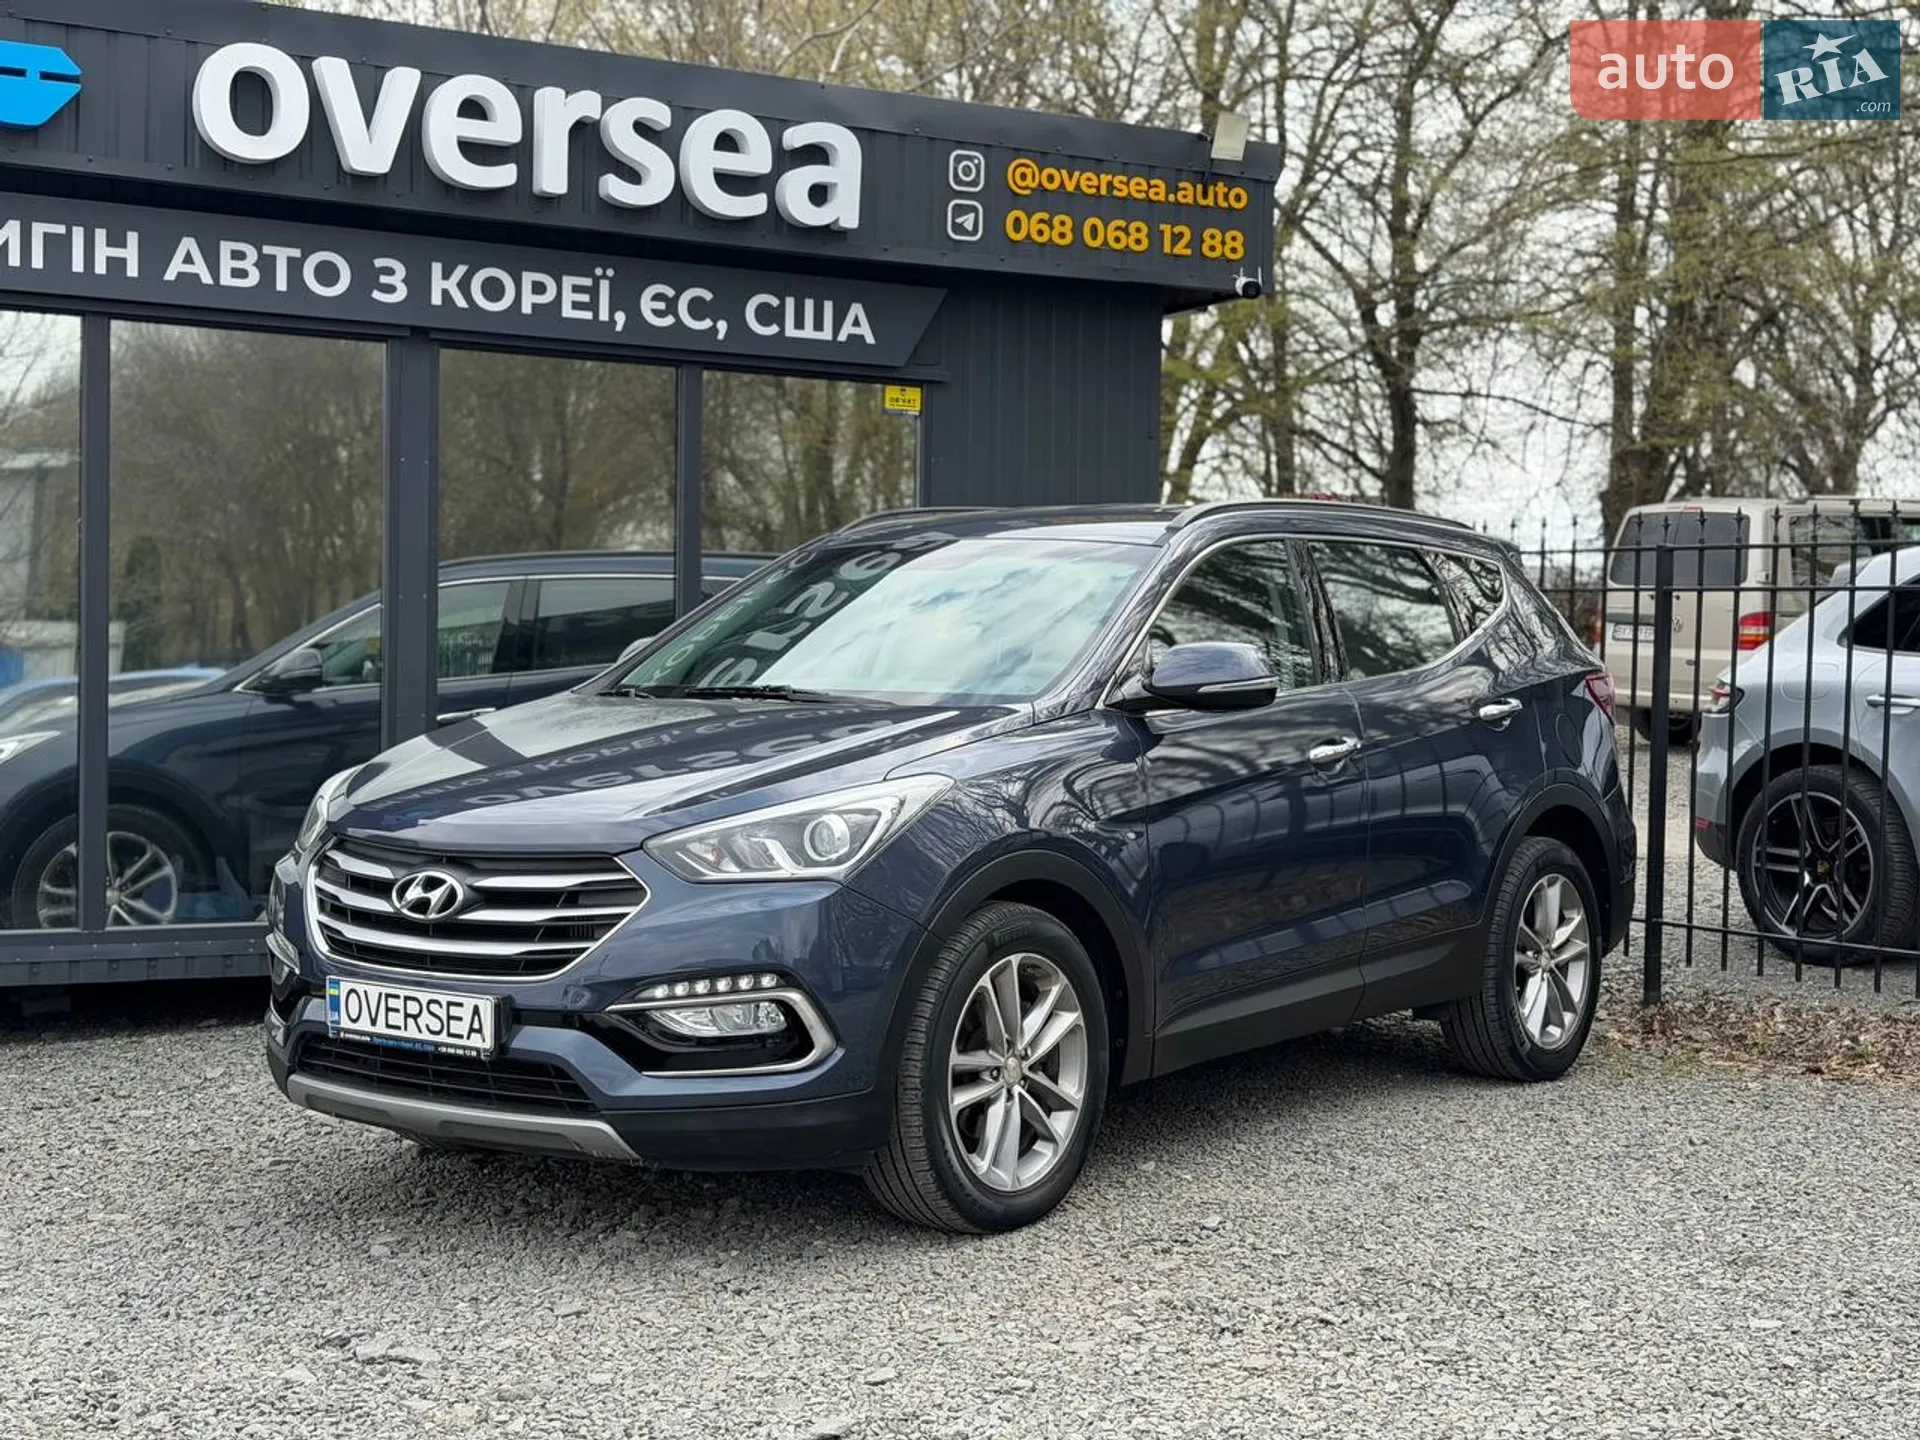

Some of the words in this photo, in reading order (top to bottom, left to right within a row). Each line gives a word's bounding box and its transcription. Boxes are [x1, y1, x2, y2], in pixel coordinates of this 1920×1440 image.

[192, 41, 864, 230] oversea
[1006, 157, 1249, 211] @oversea.auto
[1004, 209, 1074, 246] 068
[1082, 216, 1149, 252] 068
[1159, 223, 1193, 256] 12
[1201, 227, 1246, 261] 88
[162, 236, 352, 298] АВТО
[371, 257, 408, 304] З
[430, 261, 627, 332] КОРЕЇ,
[639, 283, 728, 341] ЄС,
[745, 293, 876, 345] США
[345, 988, 486, 1042] OVERSEA
